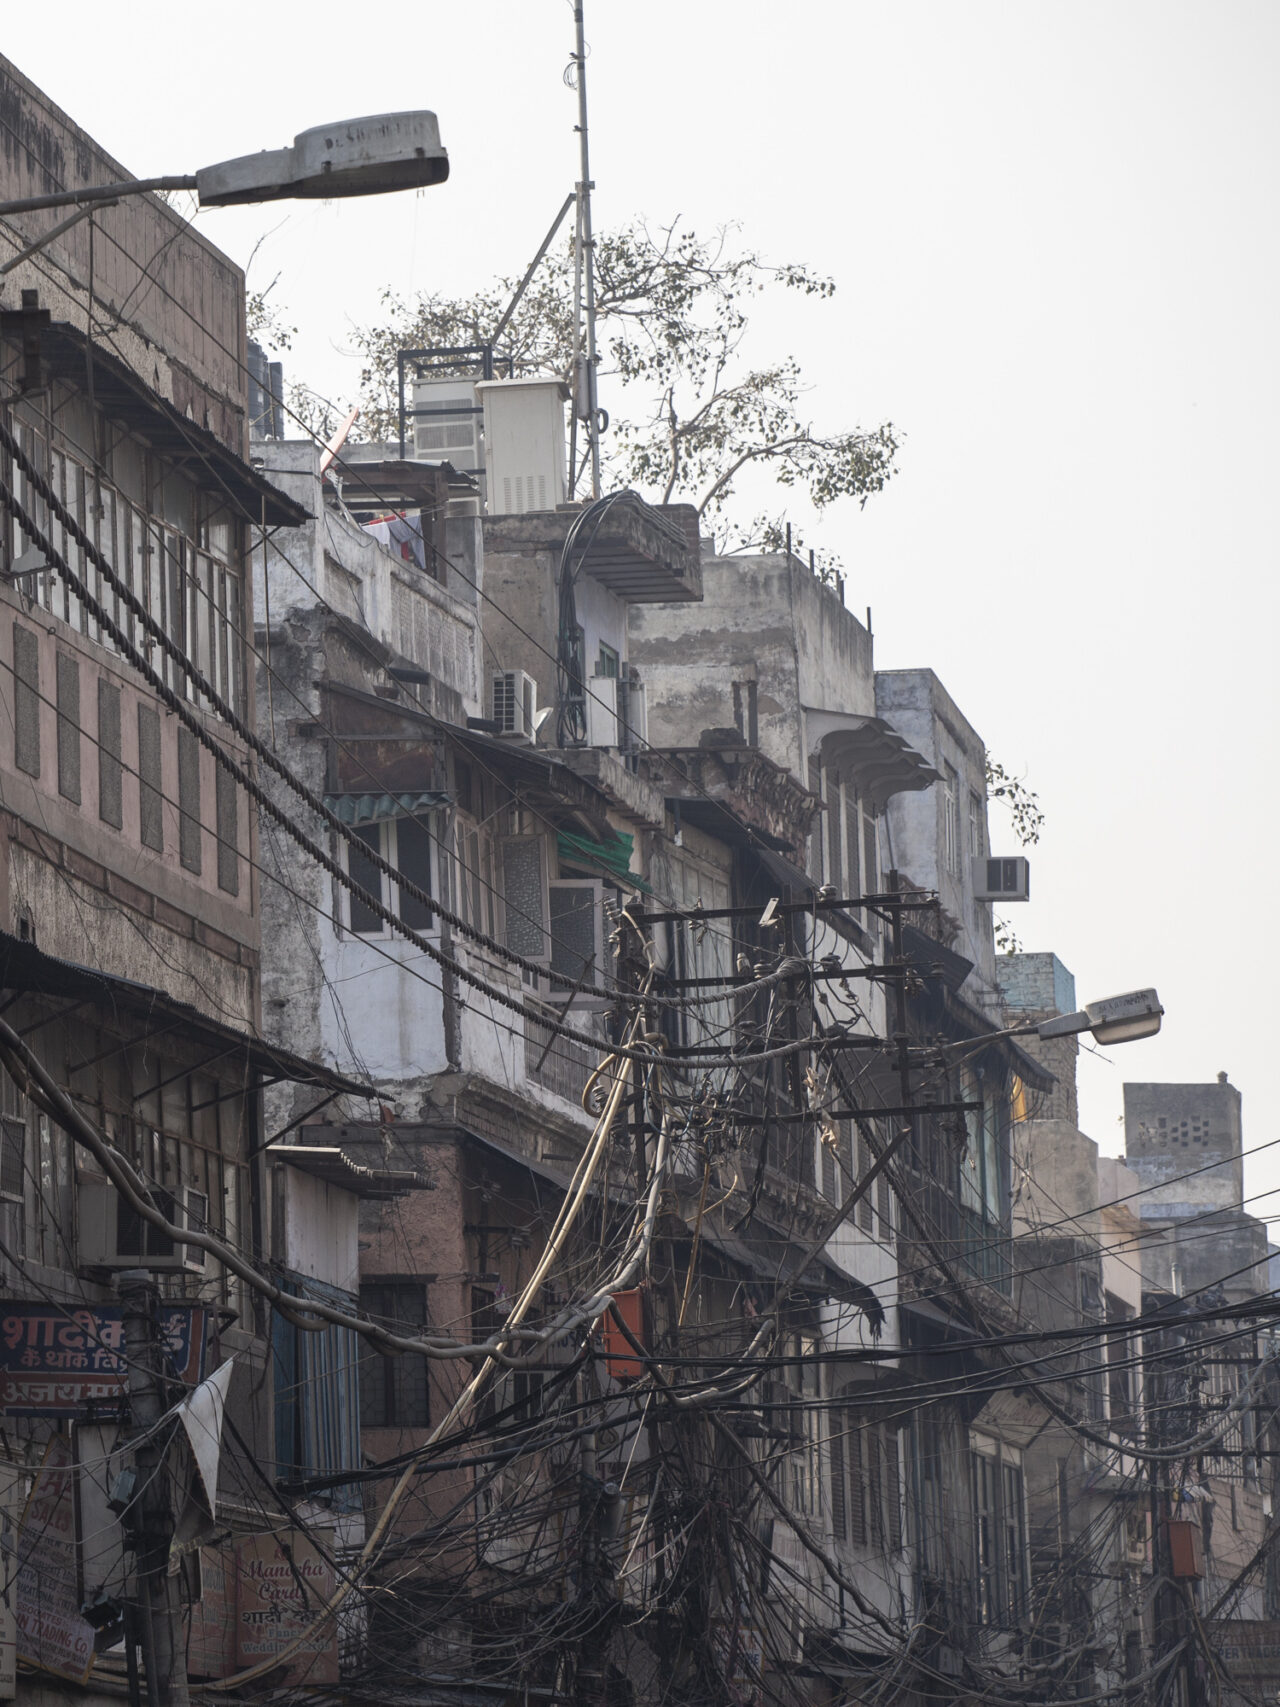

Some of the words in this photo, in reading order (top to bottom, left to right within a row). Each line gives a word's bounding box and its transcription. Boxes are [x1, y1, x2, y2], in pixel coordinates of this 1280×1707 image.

[243, 1558, 325, 1579] Manoha
[31, 1615, 73, 1648] TRADING
[242, 1642, 287, 1654] Weddin
